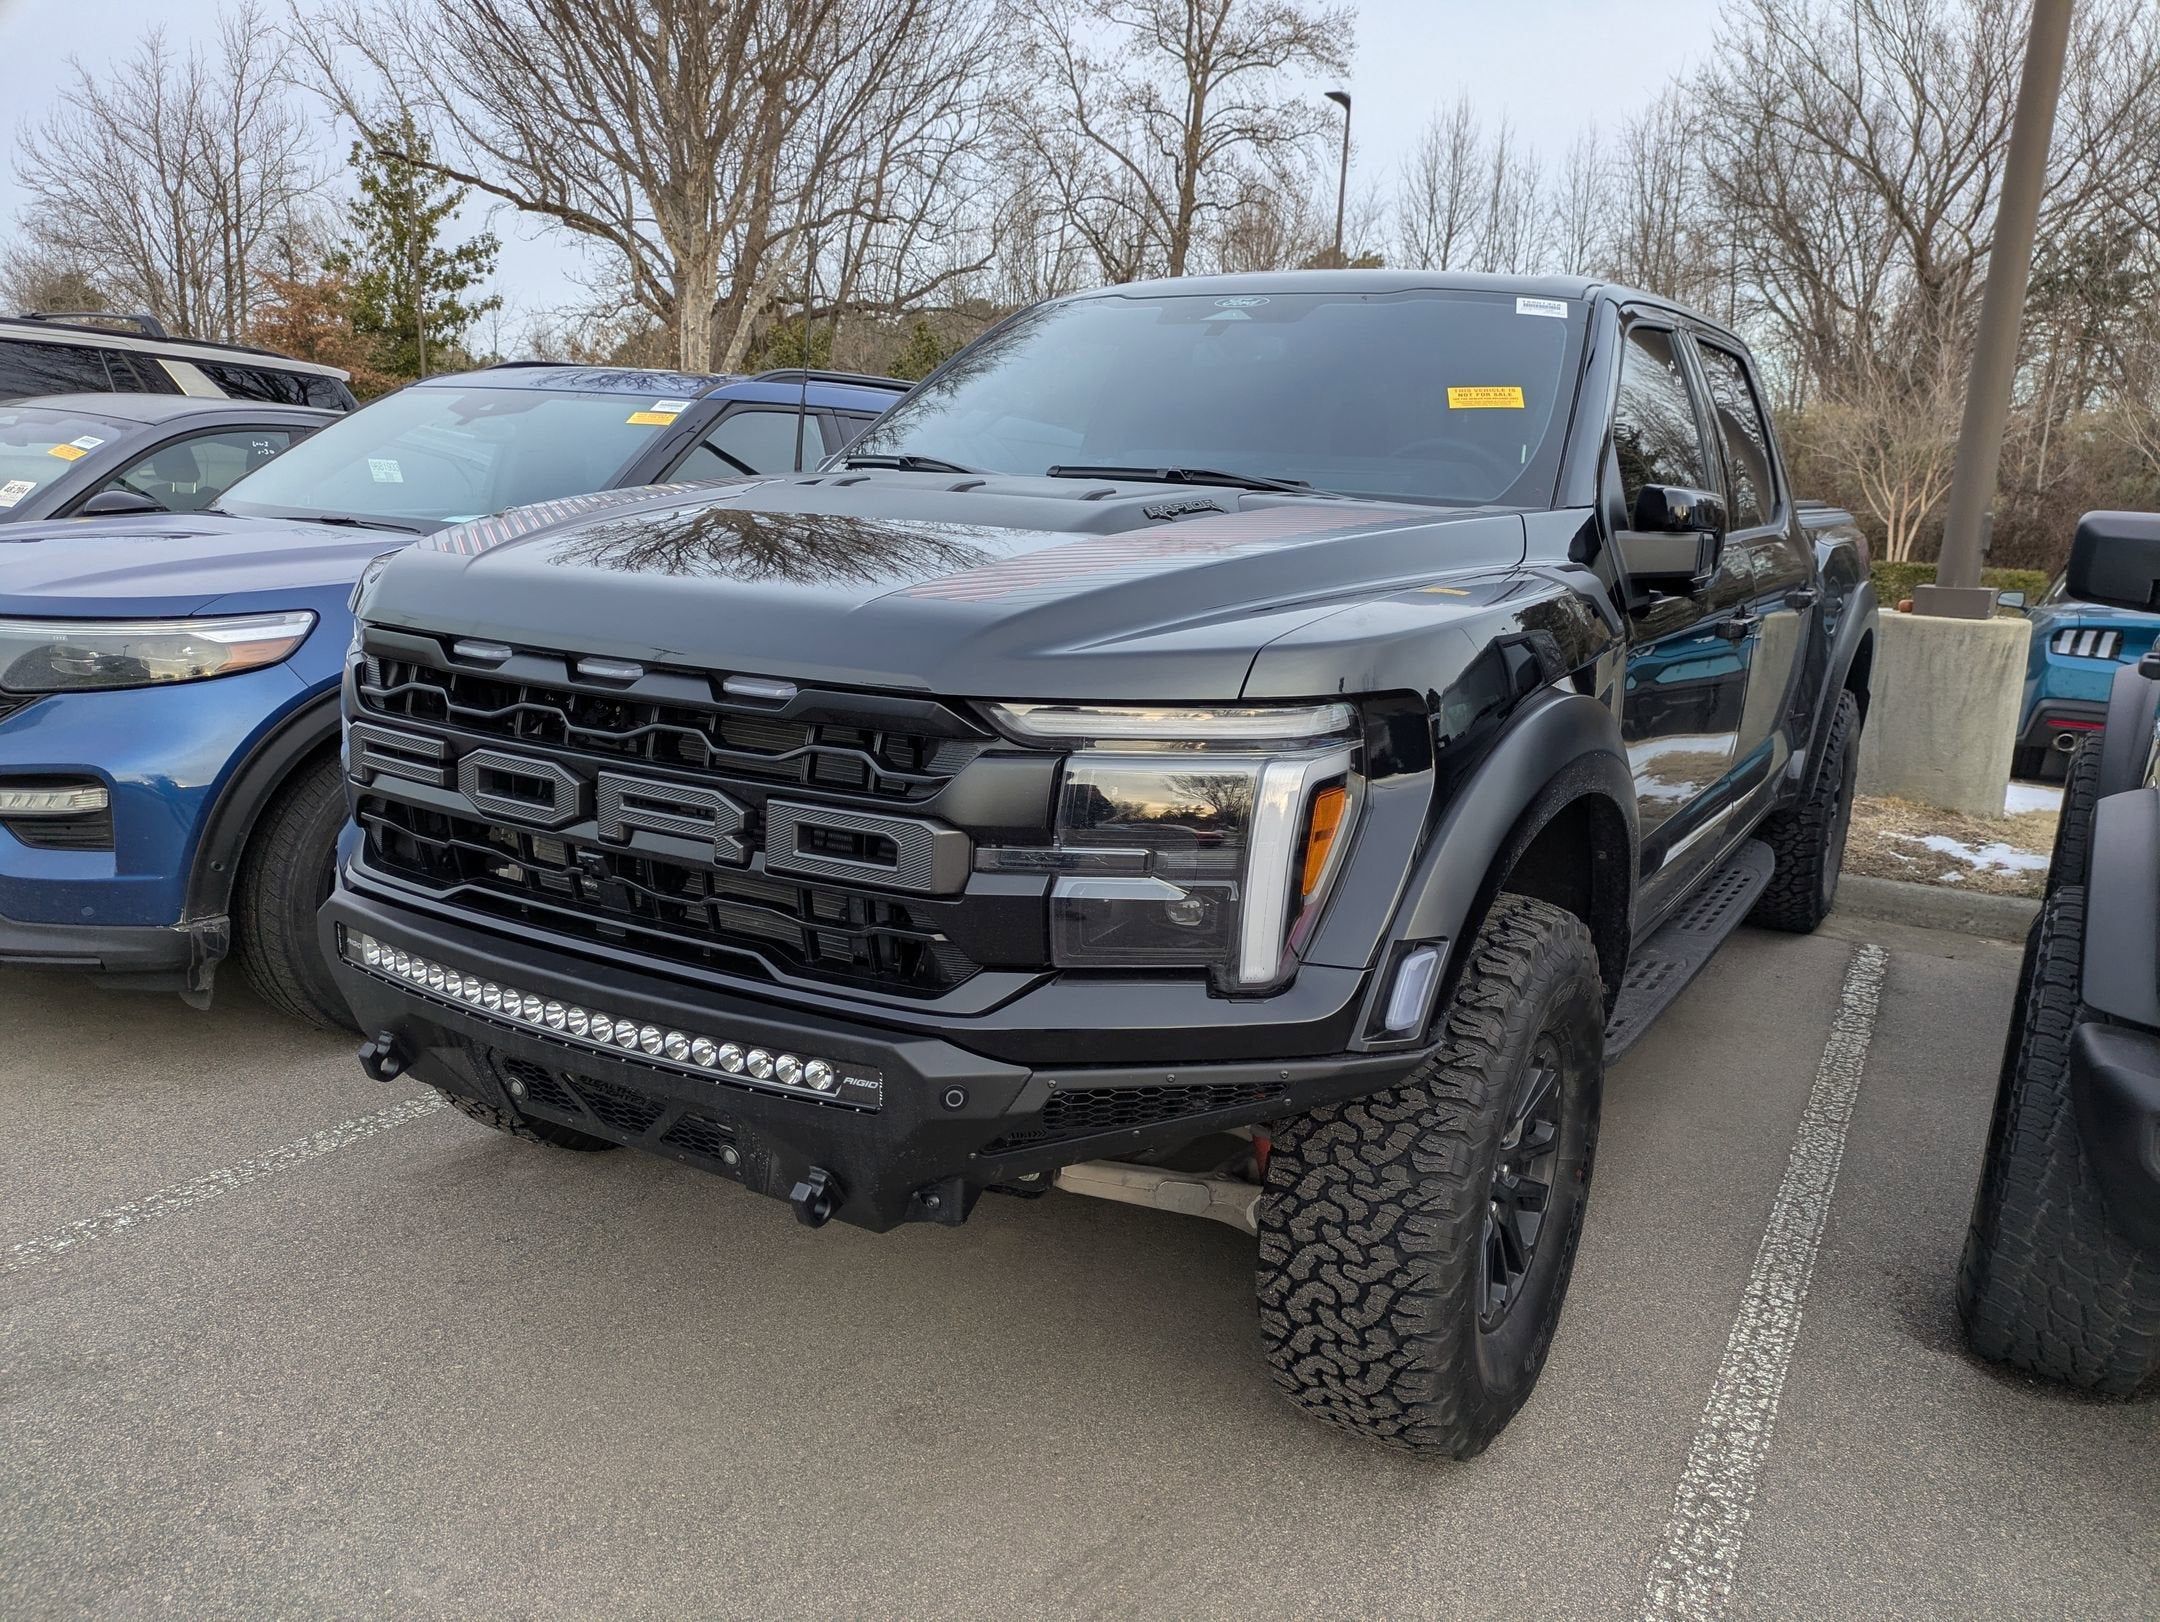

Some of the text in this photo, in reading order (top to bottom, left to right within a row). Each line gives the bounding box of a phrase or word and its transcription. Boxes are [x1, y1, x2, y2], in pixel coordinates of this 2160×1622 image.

[1143, 499, 1229, 522] RAPTOR
[346, 720, 971, 903] FORD
[843, 1076, 879, 1089] RIGID
